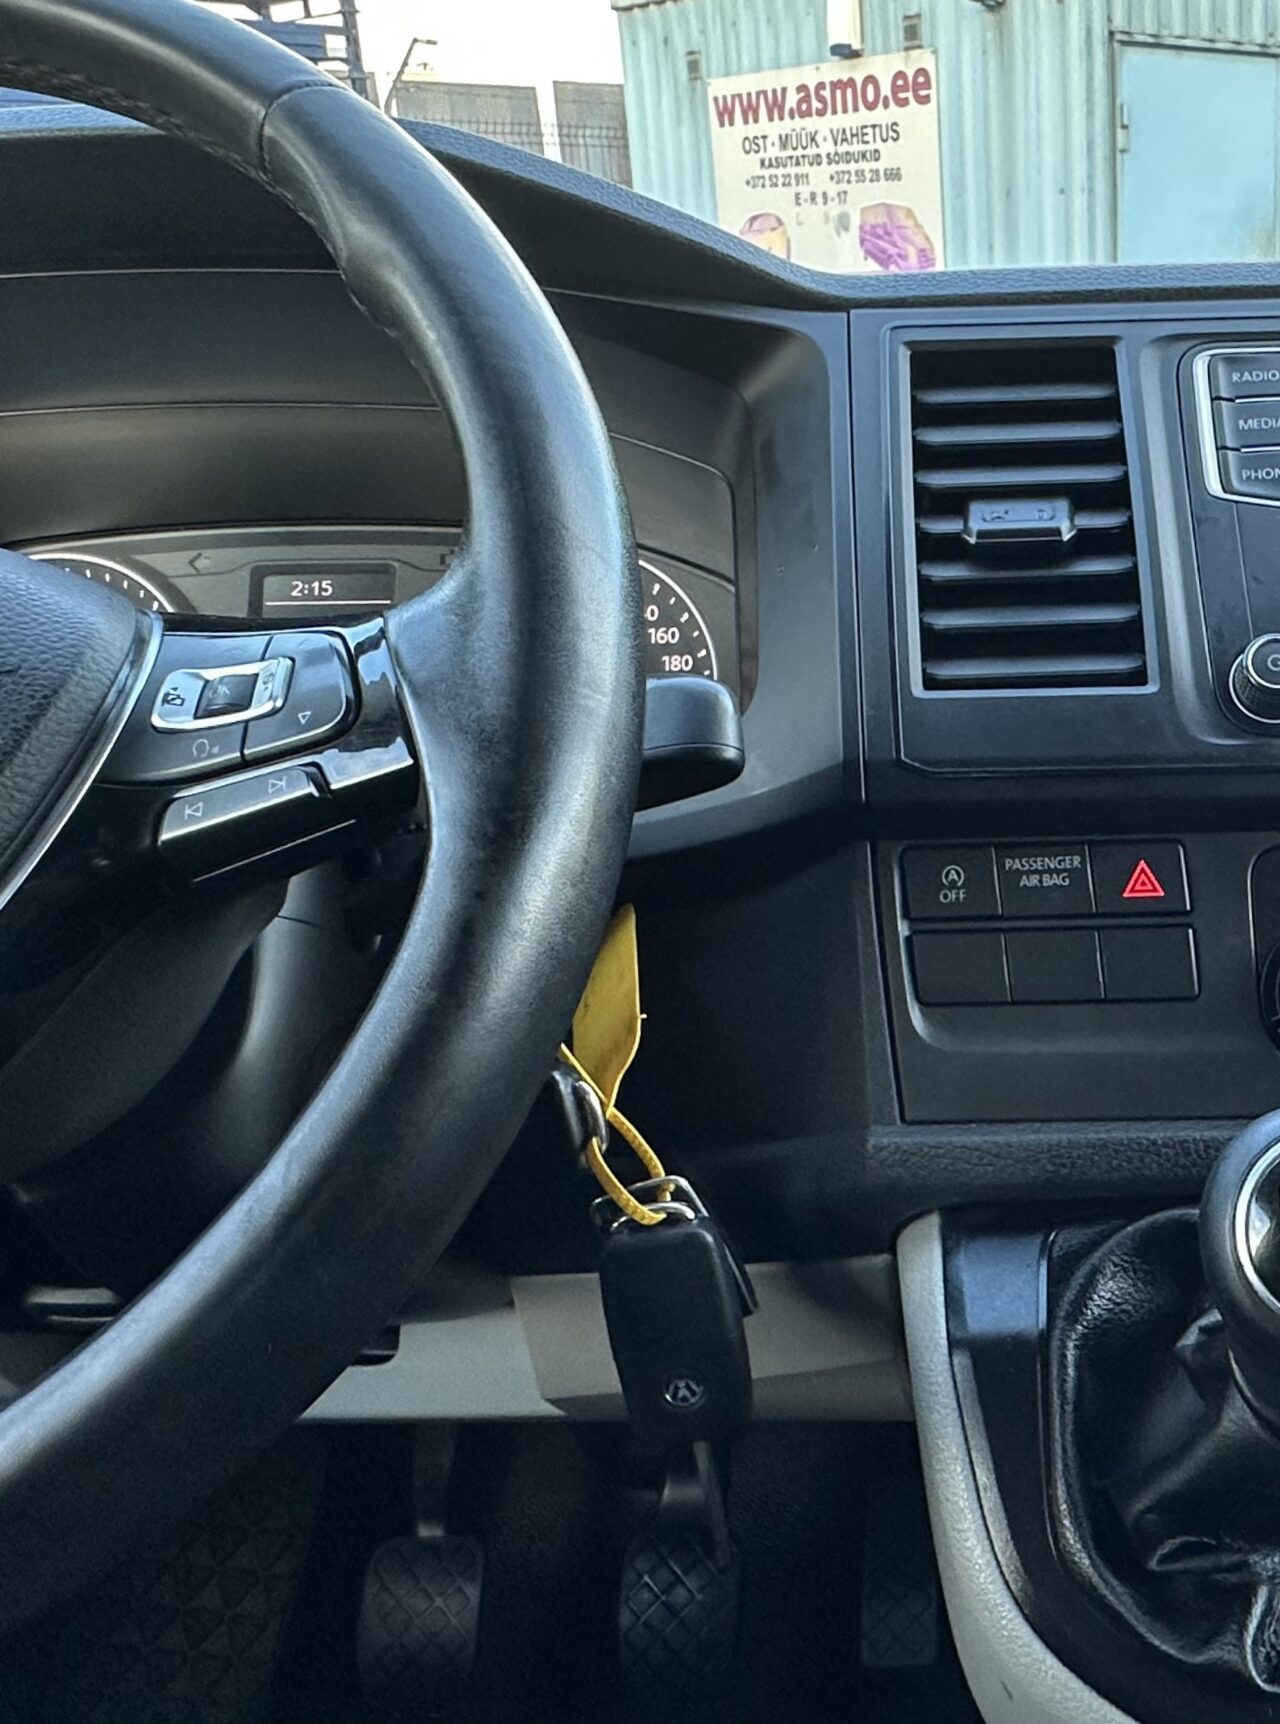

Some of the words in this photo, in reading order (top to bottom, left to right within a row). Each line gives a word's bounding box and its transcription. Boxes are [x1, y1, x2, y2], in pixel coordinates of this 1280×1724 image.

[712, 67, 932, 128] www.asmo.ee
[742, 135, 769, 154] OST
[779, 127, 820, 152] MÜÜK
[829, 122, 900, 147] VAHETUS
[759, 153, 823, 170] KASUTATUD
[745, 175, 766, 189] +372
[781, 174, 793, 187] 22
[794, 172, 810, 186] 911
[829, 170, 852, 185] +372
[1231, 369, 1280, 383] RADIO
[290, 580, 333, 597] 2:15
[648, 626, 680, 645] 160
[661, 654, 694, 672] 180
[1005, 855, 1082, 871] PASSENGER
[939, 889, 967, 903] OFF
